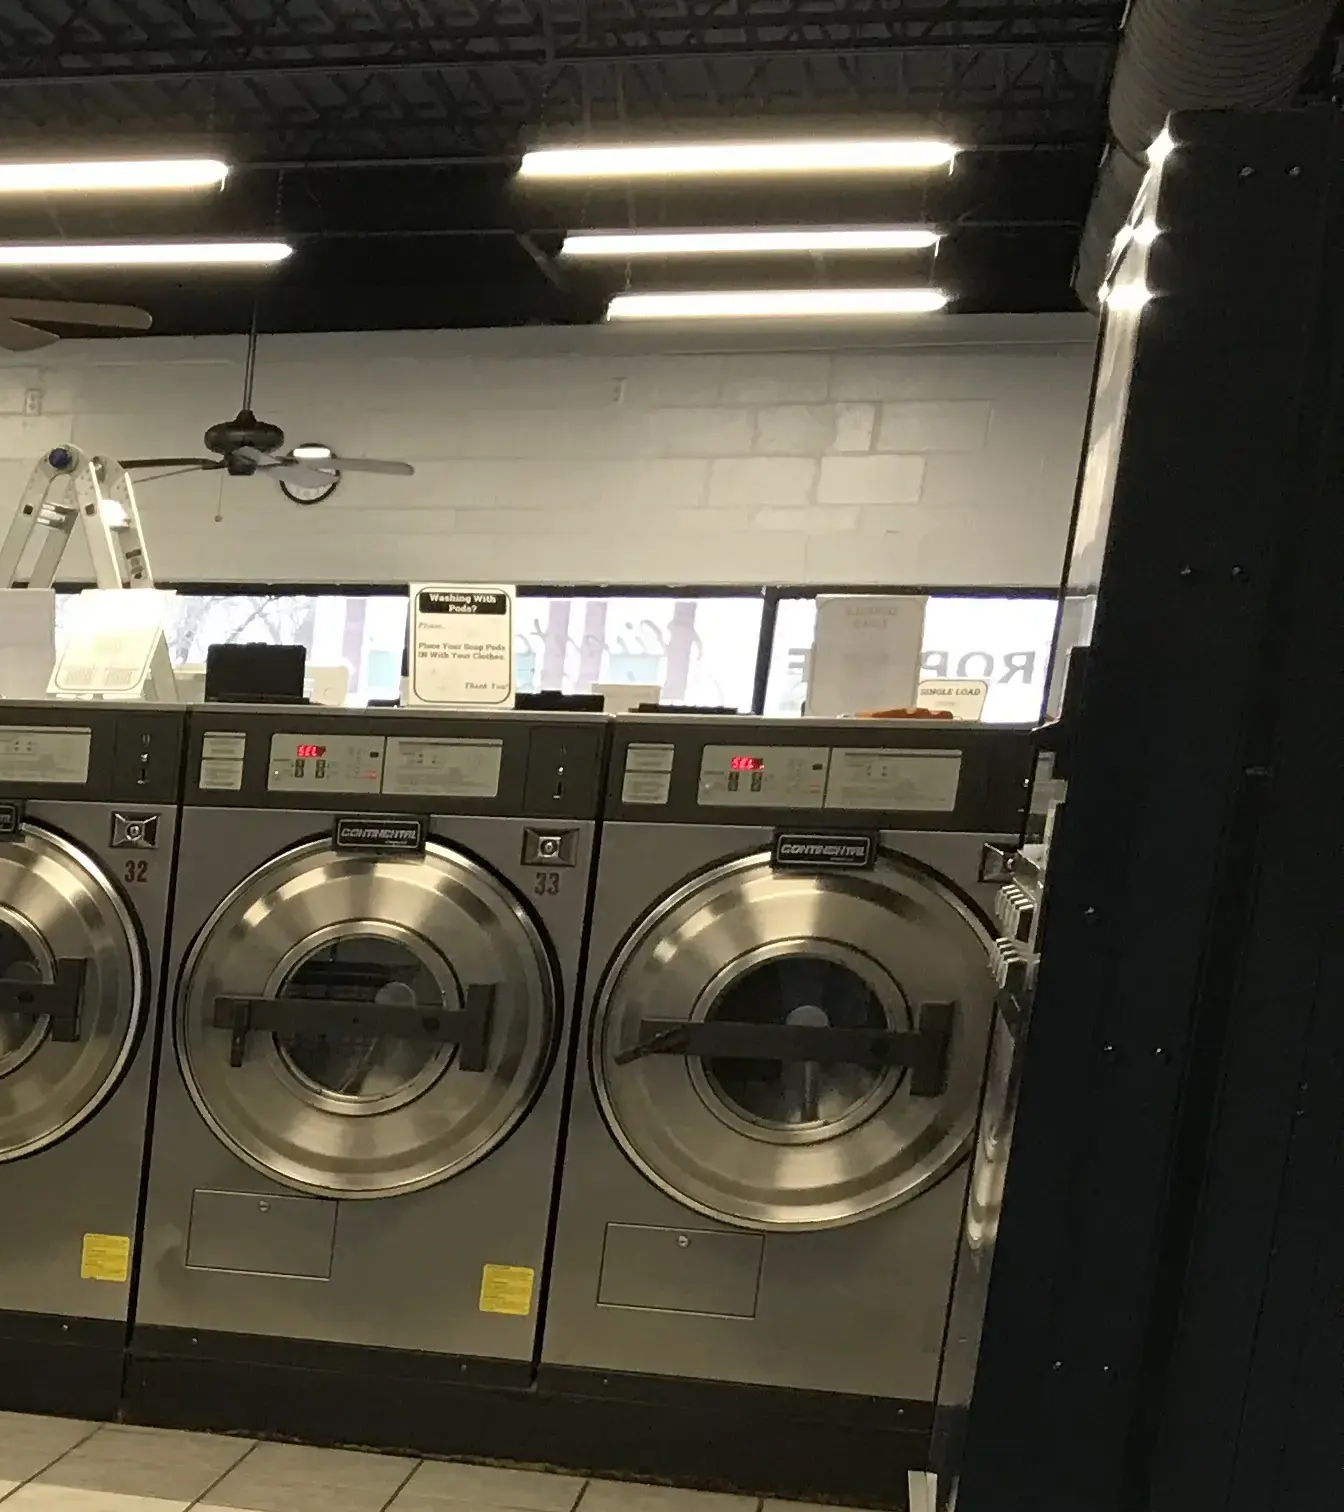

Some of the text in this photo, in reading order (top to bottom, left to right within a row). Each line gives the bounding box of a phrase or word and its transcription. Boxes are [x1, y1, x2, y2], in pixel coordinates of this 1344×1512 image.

[429, 593, 497, 603] Washing With
[448, 604, 478, 613] Pods?
[955, 688, 981, 697] LOAD
[341, 828, 417, 840] CONTINENTAL
[124, 860, 148, 883] 32
[534, 872, 560, 896] 33
